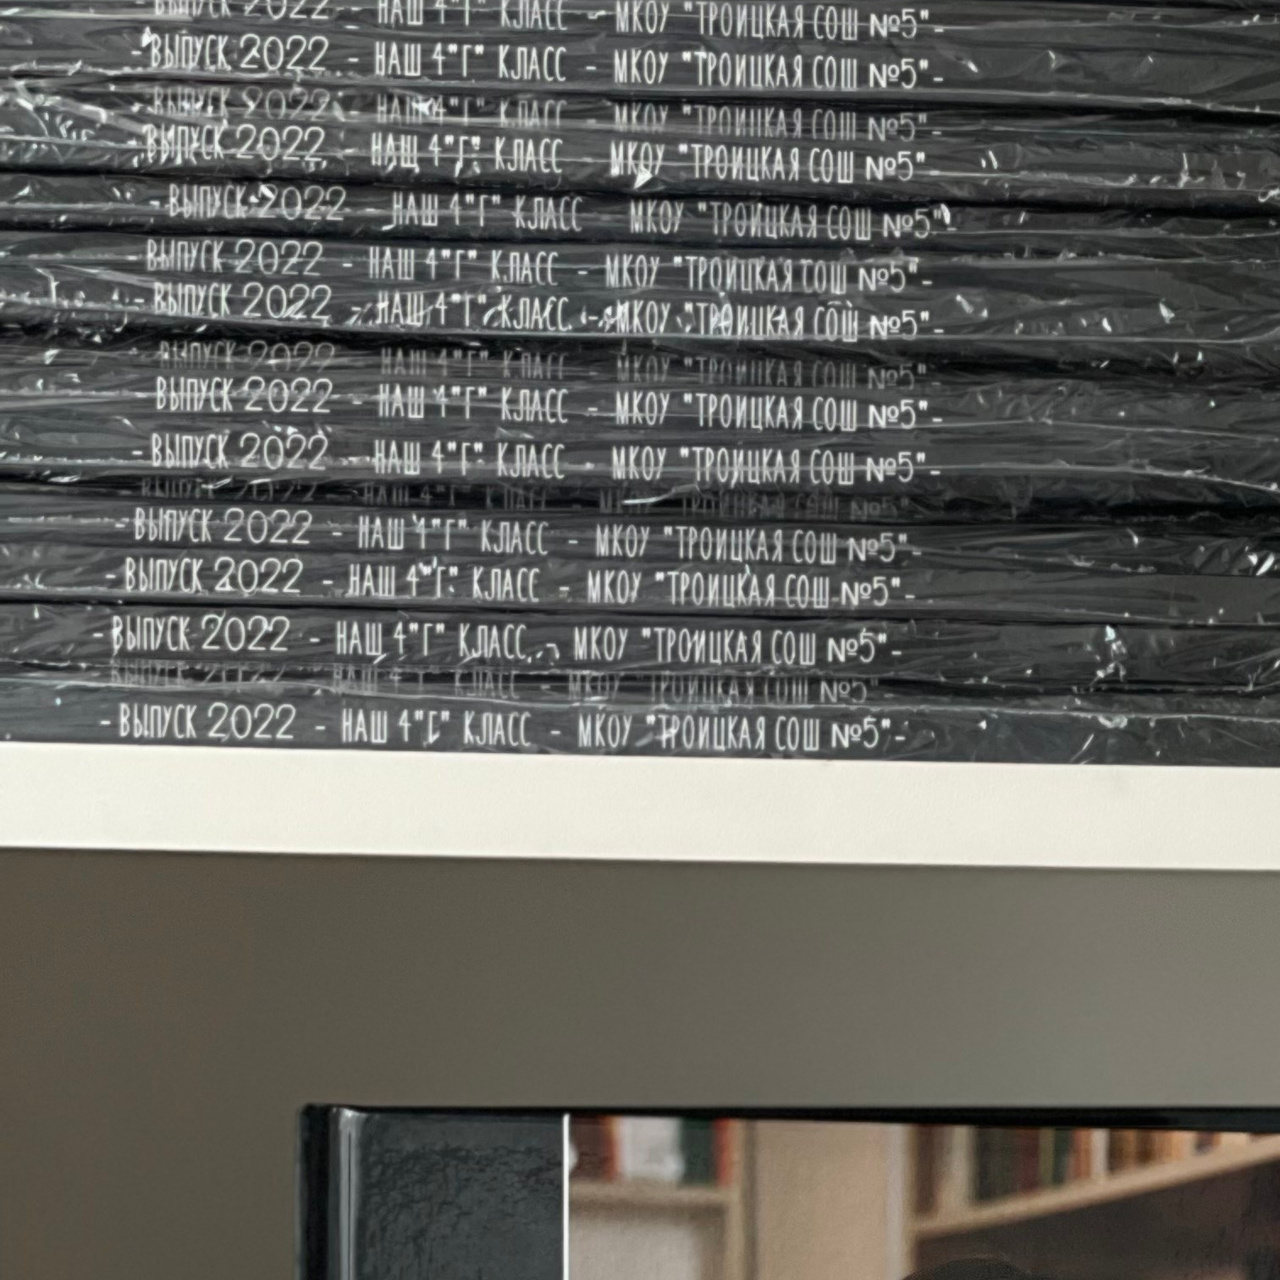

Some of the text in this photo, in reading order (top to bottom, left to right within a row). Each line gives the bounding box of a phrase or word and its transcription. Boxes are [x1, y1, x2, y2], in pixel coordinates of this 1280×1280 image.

[379, 0, 422, 25] НАШ
[501, 0, 567, 30] КЛАСС
[616, 1, 669, 33] МКОУ
[684, 3, 803, 39] "ТРОИЦКАЯ
[813, 6, 857, 40] СОШ
[870, 9, 928, 38] №5"
[150, 34, 228, 69] ВЫПУСК
[240, 34, 329, 71] 2022
[375, 41, 421, 76] НАШ
[499, 45, 566, 82] КЛАСС
[614, 50, 668, 84] МКОУ
[682, 51, 801, 88] "ТРОИЦКАЯ
[812, 56, 857, 91] СОШ
[869, 59, 928, 89] №5"
[146, 124, 225, 160] ВЫПУСК
[236, 124, 325, 161] 2022
[371, 132, 417, 168] НАШ
[495, 138, 563, 173] КЛАСС
[611, 141, 665, 176] МКОУ
[679, 143, 798, 182] "ТРОИЦКАЯ
[809, 148, 853, 183] СОШ
[865, 152, 925, 181] №5"
[169, 184, 247, 219] ВЫПУСК
[258, 184, 346, 220] 2022
[392, 192, 438, 227] НАШ
[515, 196, 582, 232] КЛАСС
[630, 199, 684, 234] МКОУ
[699, 201, 817, 240] "ТРОИЦКАЯ
[827, 206, 871, 240] СОШ
[883, 208, 942, 238] №5"
[147, 239, 223, 272] ВЫПУСК
[235, 238, 322, 275] 2022
[370, 247, 414, 280] НАШ
[492, 251, 558, 286] КЛАСС
[606, 254, 659, 287] МКОУ
[674, 256, 792, 292] "ТРОИЦКАЯ
[802, 260, 846, 294] СОШ
[858, 262, 918, 292] №5"
[154, 282, 231, 316] ВЫПУСК
[243, 282, 331, 319] 2022
[378, 291, 424, 326] НАШ
[501, 295, 568, 331] КЛАСС
[617, 300, 670, 334] МКОУ
[685, 302, 804, 340] "ТРОИЦКАЯ
[814, 308, 858, 342] СОШ
[870, 311, 929, 340] №5"
[156, 376, 233, 412] ВЫПУСК
[245, 376, 332, 412] 2022
[379, 384, 424, 418] НАШ
[502, 388, 568, 424] КЛАСС
[616, 391, 670, 425] МКОУ
[684, 393, 802, 431] "ТРОИЦКАЯ
[813, 397, 857, 432] СОШ
[868, 400, 928, 429] №5"
[152, 433, 229, 468] ВЫПУСК
[240, 433, 328, 470] 2022
[374, 440, 420, 475] НАШ
[498, 443, 565, 479] КЛАСС
[612, 446, 666, 480] МКОУ
[681, 447, 799, 486] "ТРОИЦКАЯ
[810, 451, 855, 485] СОШ
[867, 452, 925, 482] №5"
[134, 508, 212, 542] ВЫПУСК
[224, 508, 312, 544] 2022
[359, 516, 404, 550] НАШ
[482, 519, 548, 555] КЛАСС
[596, 524, 650, 558] МКОУ
[664, 526, 782, 562] "ТРОИЦКАЯ
[792, 530, 836, 565] СОШ
[848, 533, 907, 561] №5"
[126, 557, 203, 593] ВЫПУСК
[214, 557, 303, 594] 2022
[350, 563, 395, 599] НАШ
[473, 567, 540, 602] КЛАСС
[588, 570, 641, 604] МКОУ
[656, 571, 775, 608] "ТРОИЦКАЯ
[785, 574, 829, 609] СОШ
[841, 577, 900, 606] №5"
[112, 616, 190, 650] ВЫПУСК
[202, 614, 290, 651] 2022
[336, 621, 382, 656] НАШ
[459, 623, 527, 660] КЛАСС
[574, 626, 628, 661] МКОУ
[642, 628, 761, 666] "ТРОИЦКАЯ
[771, 630, 815, 665] СОШ
[828, 632, 887, 662] №5"
[120, 703, 197, 738] ВЫПУСК
[208, 702, 296, 739] 2022
[342, 708, 387, 743] НАШ
[463, 712, 531, 747] КЛАСС
[579, 713, 632, 749] МКОУ
[646, 714, 765, 751] "ТРОИЦКАЯ
[776, 716, 820, 751] СОШ
[831, 718, 890, 749] №5"
